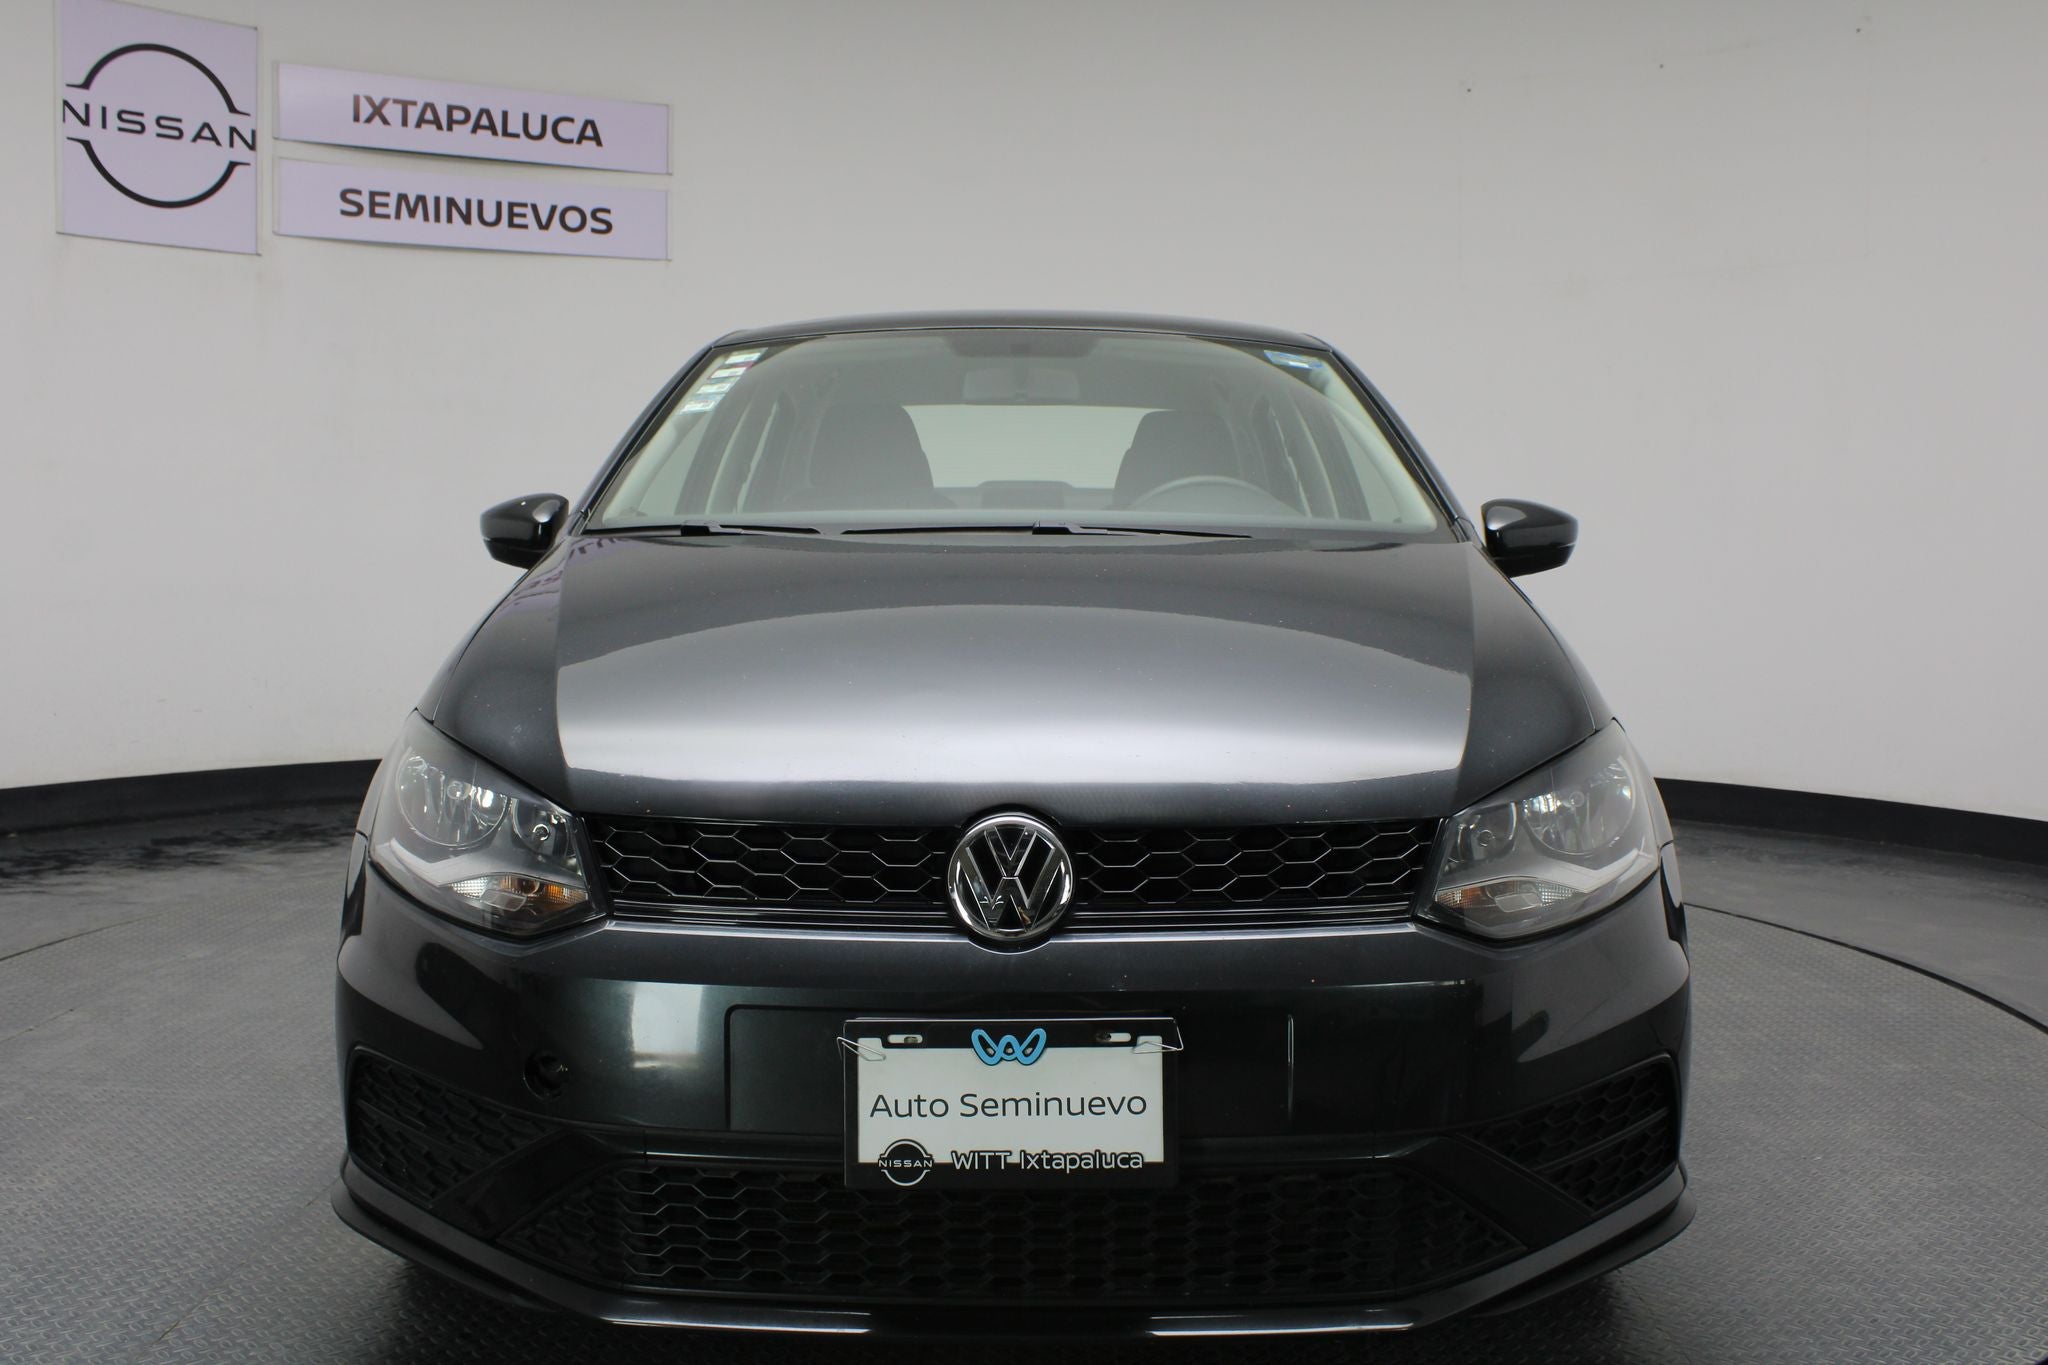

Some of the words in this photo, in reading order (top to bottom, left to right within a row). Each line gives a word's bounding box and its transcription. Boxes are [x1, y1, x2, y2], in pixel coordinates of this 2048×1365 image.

[62, 99, 257, 152] NISSAN
[352, 94, 604, 148] IXTAPALUCA
[339, 187, 614, 236] SEMINUEVOS
[869, 1094, 949, 1118] Auto
[959, 1091, 1147, 1118] Seminuevo
[878, 1159, 933, 1168] NISSAN
[951, 1151, 1011, 1170] WITT
[1020, 1150, 1143, 1173] Ixtapaluca
